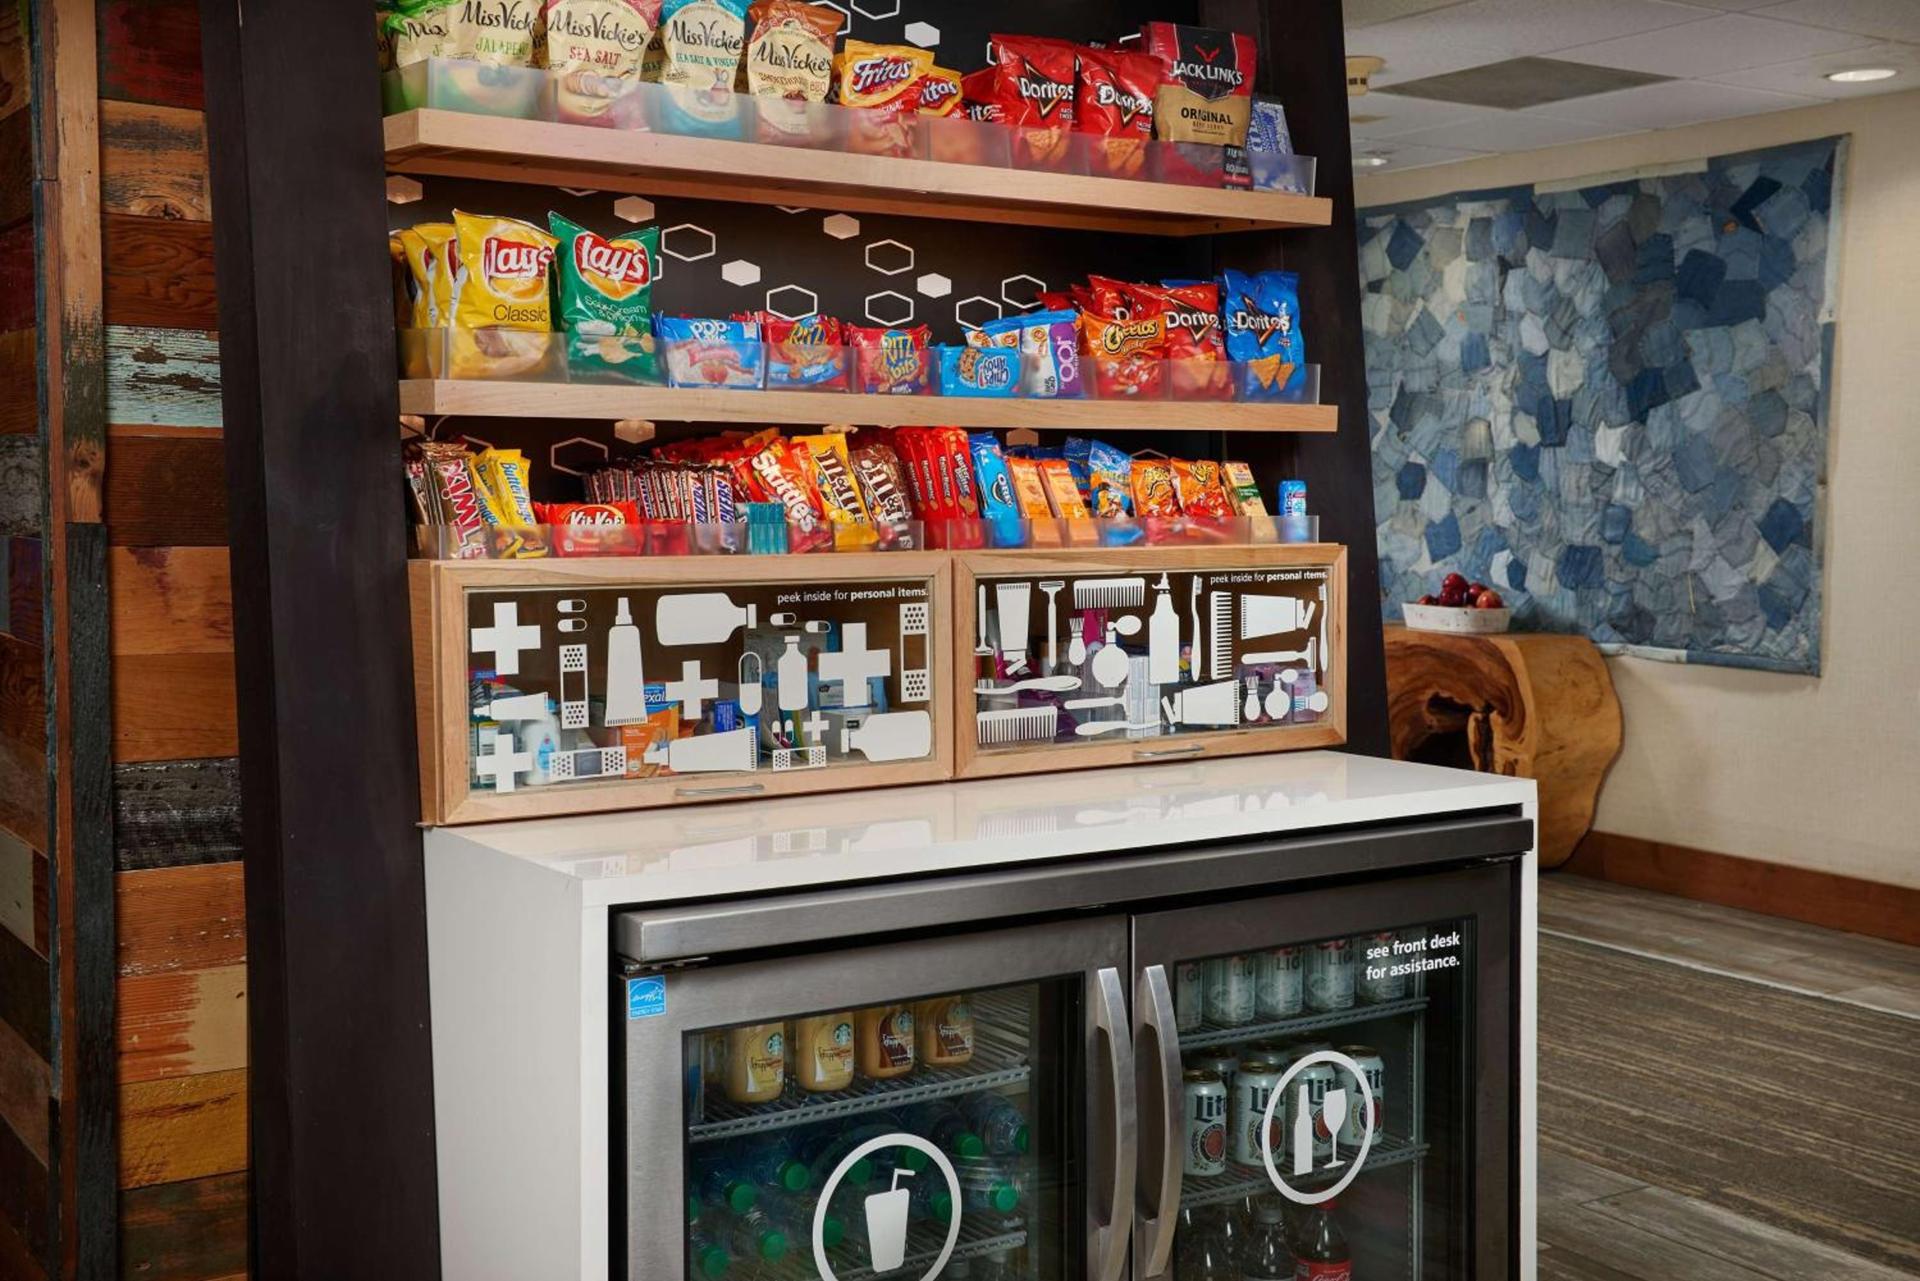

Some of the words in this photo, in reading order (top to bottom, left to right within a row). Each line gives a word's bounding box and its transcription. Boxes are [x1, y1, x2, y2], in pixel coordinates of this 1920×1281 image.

[549, 10, 591, 36] Miss
[588, 12, 646, 51] Vickie's
[669, 20, 702, 45] Miss
[569, 46, 591, 62] SEA
[594, 50, 622, 66] SALT
[753, 41, 785, 68] Miss
[853, 57, 913, 92] Fritos
[1169, 60, 1206, 80] JACK
[1020, 77, 1074, 101] Doritos
[1181, 107, 1233, 125] ORIGINAL
[489, 239, 553, 278] Lay's
[581, 236, 646, 281] Lay's
[493, 303, 548, 323] Classic
[1237, 311, 1290, 331] Doritos
[881, 334, 914, 365] RITZ
[1103, 320, 1159, 353] Cheetos
[442, 458, 482, 547] TWIX
[751, 451, 817, 533] Skittles
[997, 473, 1013, 508] OREO
[1210, 574, 1229, 586] peek
[1230, 573, 1253, 583] inside
[1254, 572, 1265, 581] for
[1266, 571, 1303, 583] personal
[1303, 570, 1328, 580] items.
[777, 593, 801, 606] peek
[803, 591, 832, 602] inside
[834, 589, 849, 600] for
[850, 587, 896, 602] personal
[897, 586, 929, 598] items.
[1366, 945, 1390, 960] see
[1392, 937, 1427, 957] front
[1430, 931, 1461, 949] desk
[1365, 964, 1387, 981] for
[1389, 954, 1461, 976] assistance.
